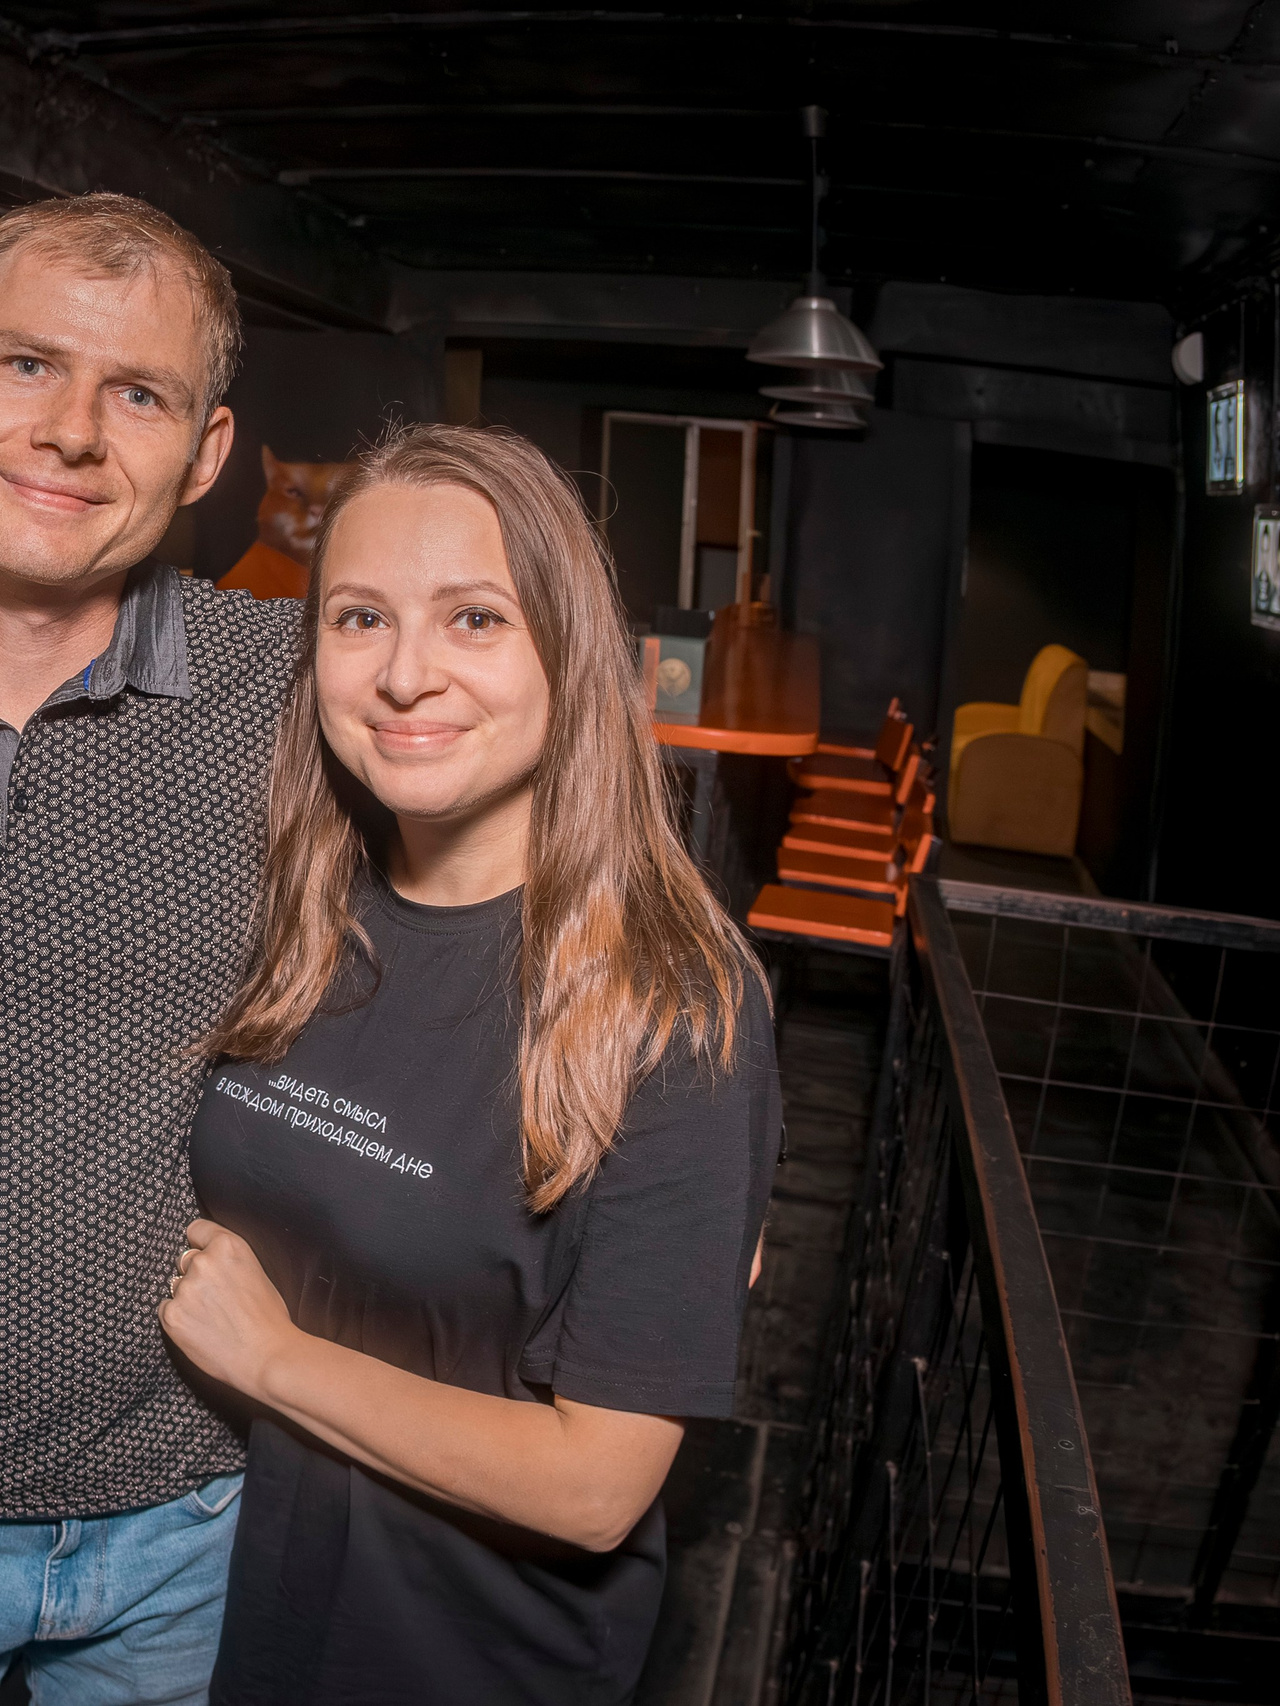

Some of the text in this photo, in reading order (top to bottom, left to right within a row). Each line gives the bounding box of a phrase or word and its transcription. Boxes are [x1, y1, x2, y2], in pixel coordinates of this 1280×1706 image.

[223, 1080, 286, 1118] каждом
[283, 1105, 394, 1164] приходящем
[389, 1152, 434, 1180] дне
[332, 1097, 388, 1134] смысл
